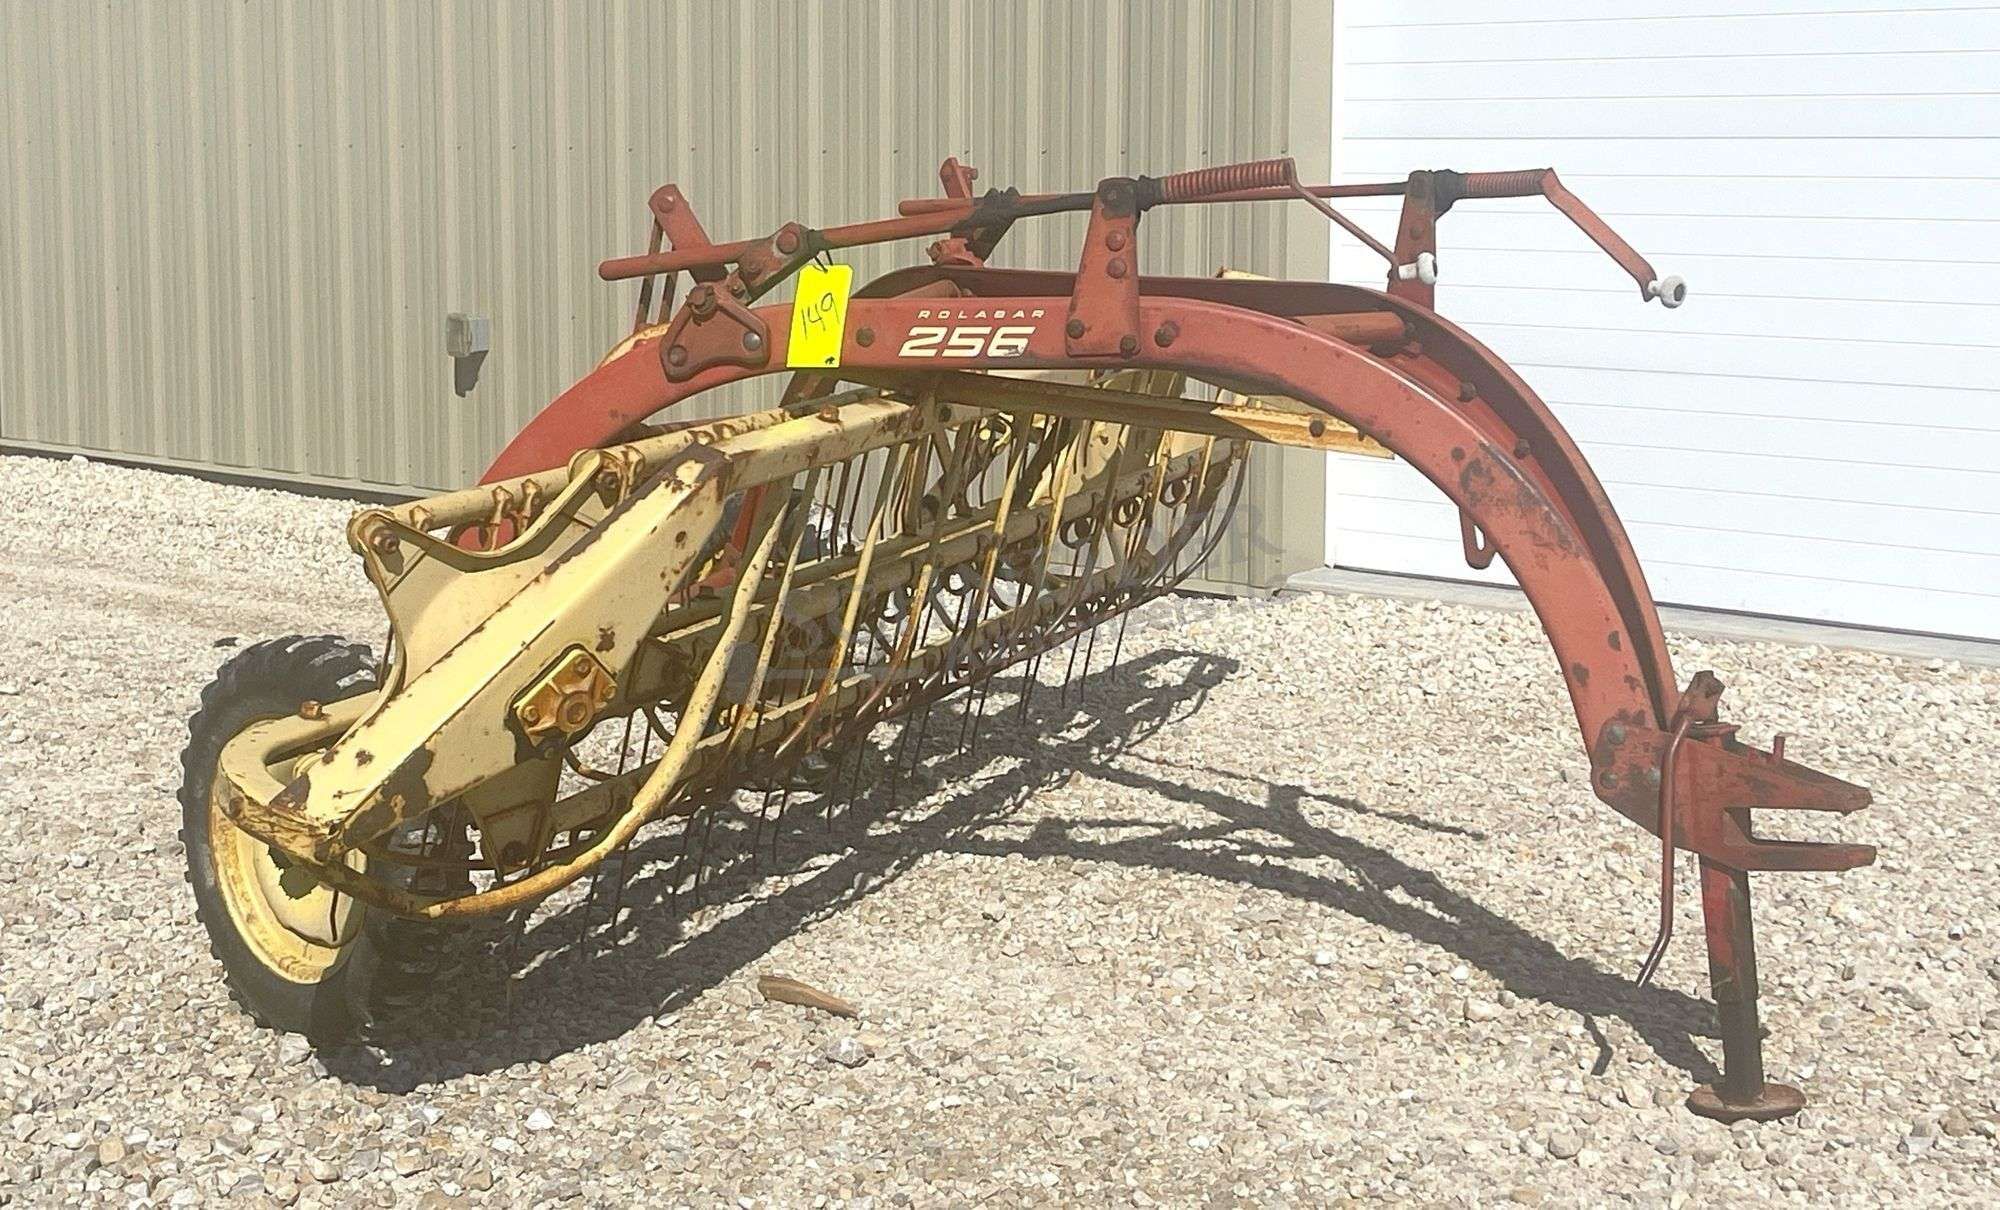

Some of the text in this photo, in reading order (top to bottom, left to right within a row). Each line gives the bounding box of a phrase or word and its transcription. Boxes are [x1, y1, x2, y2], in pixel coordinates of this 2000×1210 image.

[801, 292, 840, 341] 149
[917, 309, 1046, 319] ROLABAR
[898, 326, 1037, 357] 256
